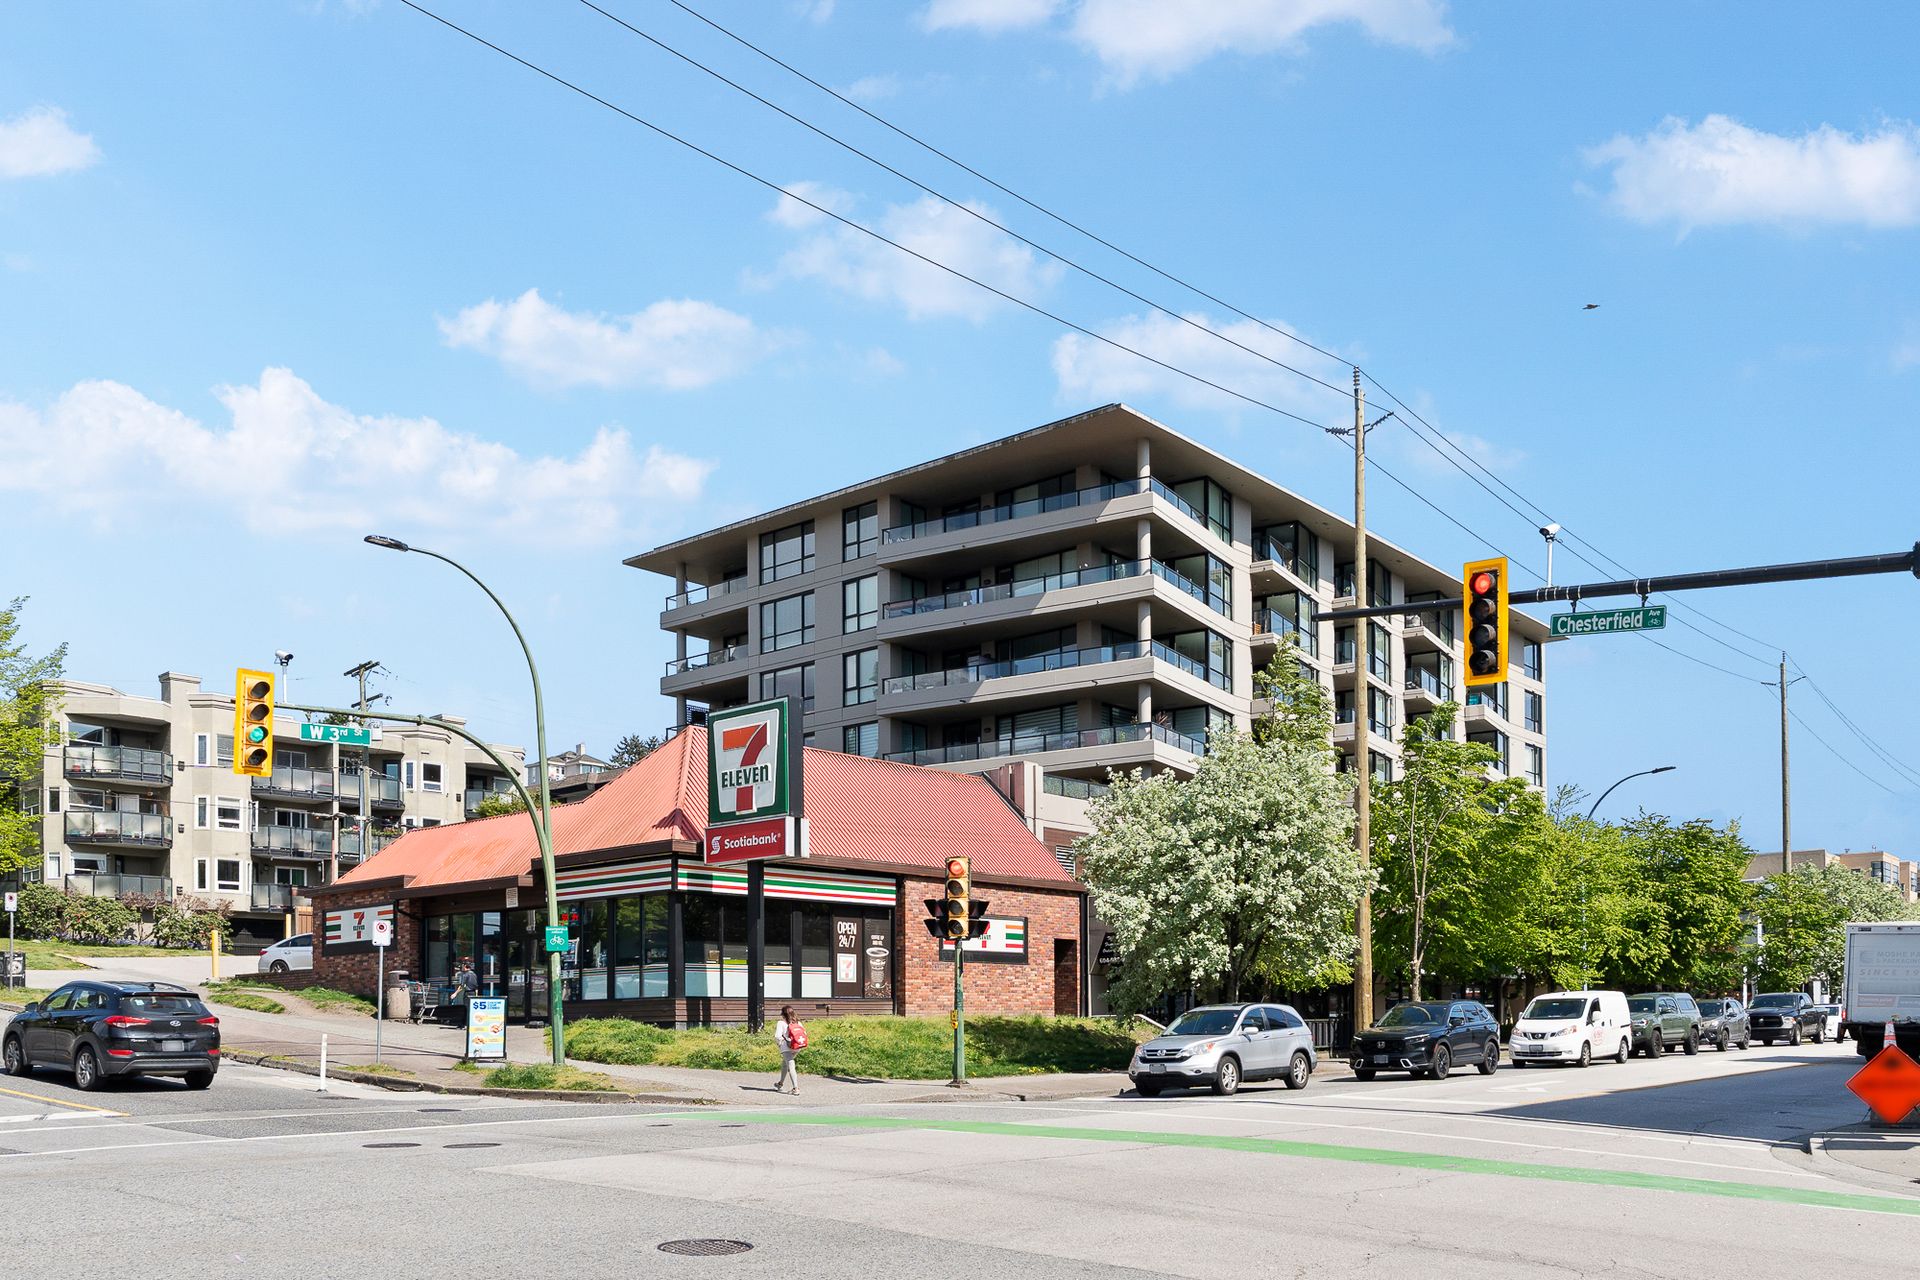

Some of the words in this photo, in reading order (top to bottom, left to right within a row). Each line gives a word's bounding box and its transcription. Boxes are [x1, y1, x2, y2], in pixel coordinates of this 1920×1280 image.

[1557, 611, 1644, 633] Chesterfield
[1648, 609, 1661, 617] Ave
[309, 724, 324, 740] W
[328, 728, 348, 741] 3rd
[354, 728, 363, 737] St
[722, 720, 770, 814] 7
[724, 832, 777, 849] Scotiabank
[353, 911, 365, 939] 7
[837, 921, 857, 934] OPEN
[838, 934, 856, 948] 24/7
[1859, 968, 1897, 976] SINCE
[472, 1001, 487, 1010] $5
